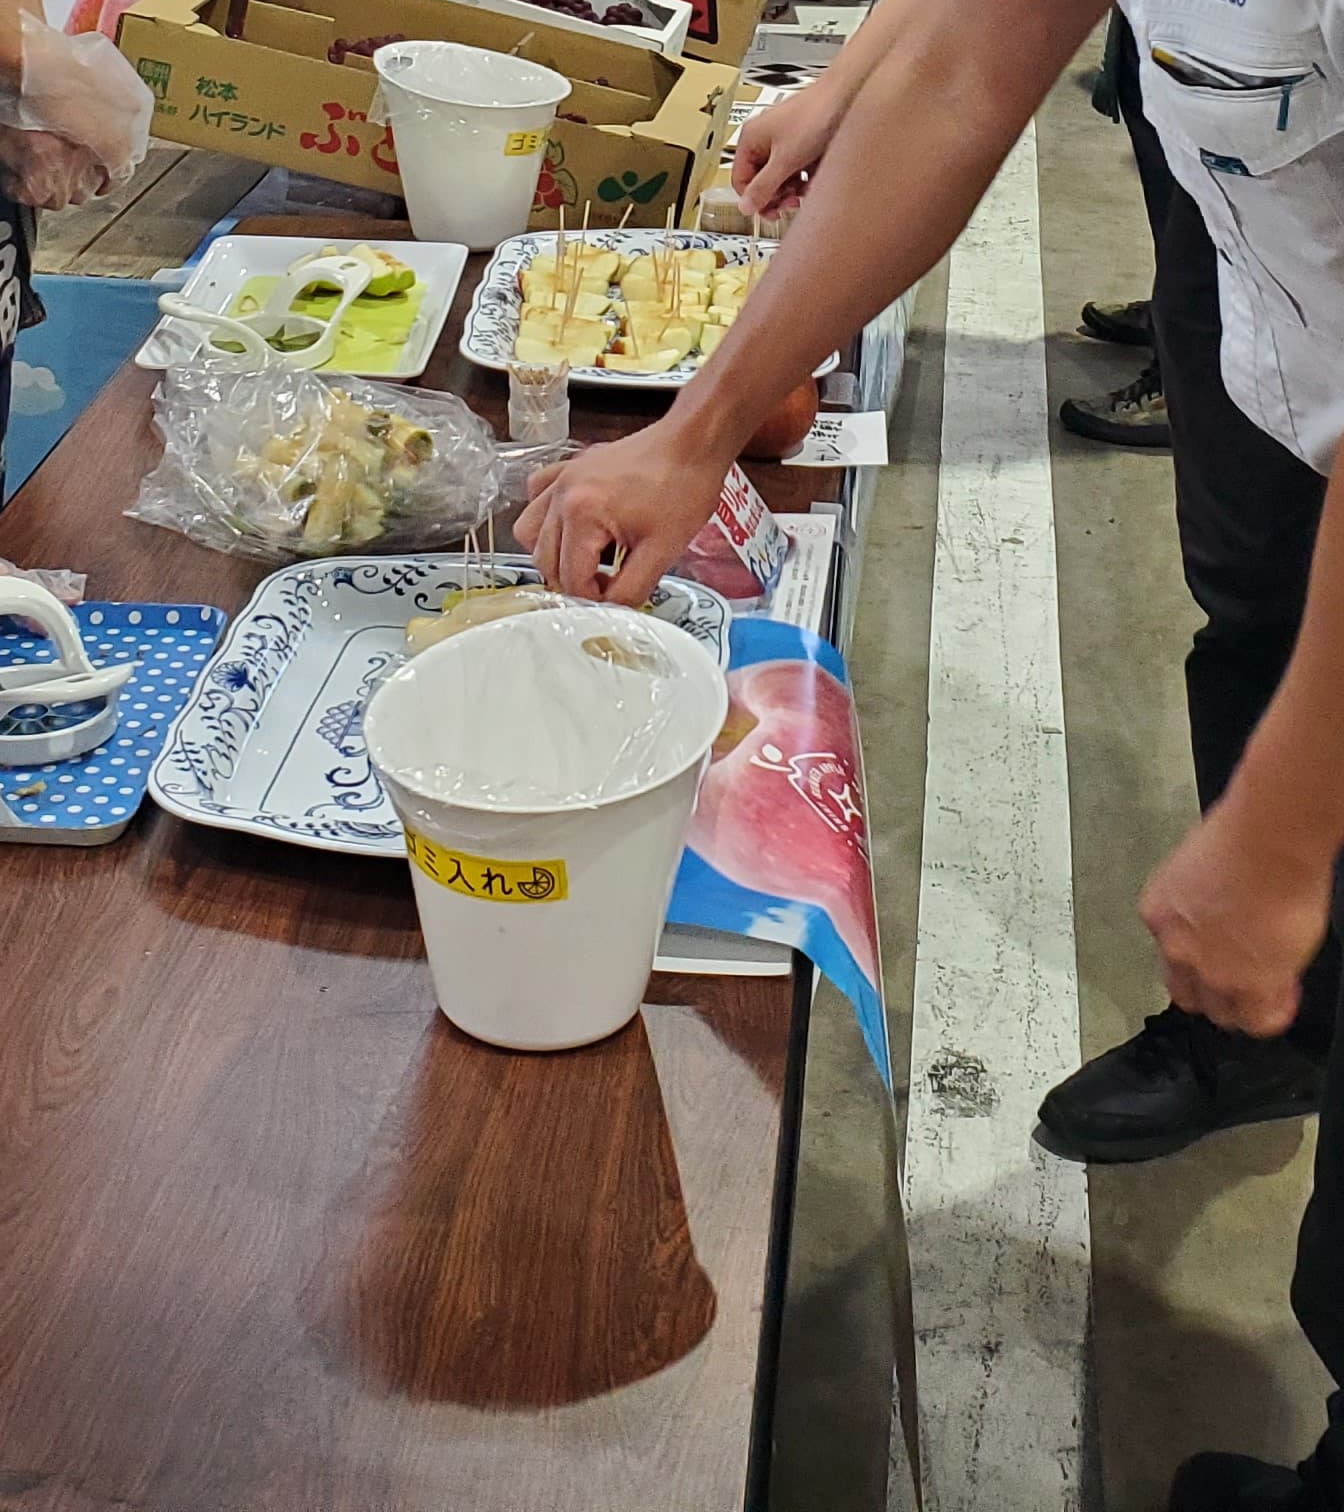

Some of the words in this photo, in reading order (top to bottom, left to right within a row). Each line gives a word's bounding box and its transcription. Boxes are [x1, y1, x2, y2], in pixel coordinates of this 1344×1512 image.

[195, 76, 239, 102] 松本
[188, 104, 286, 140] ハイランド
